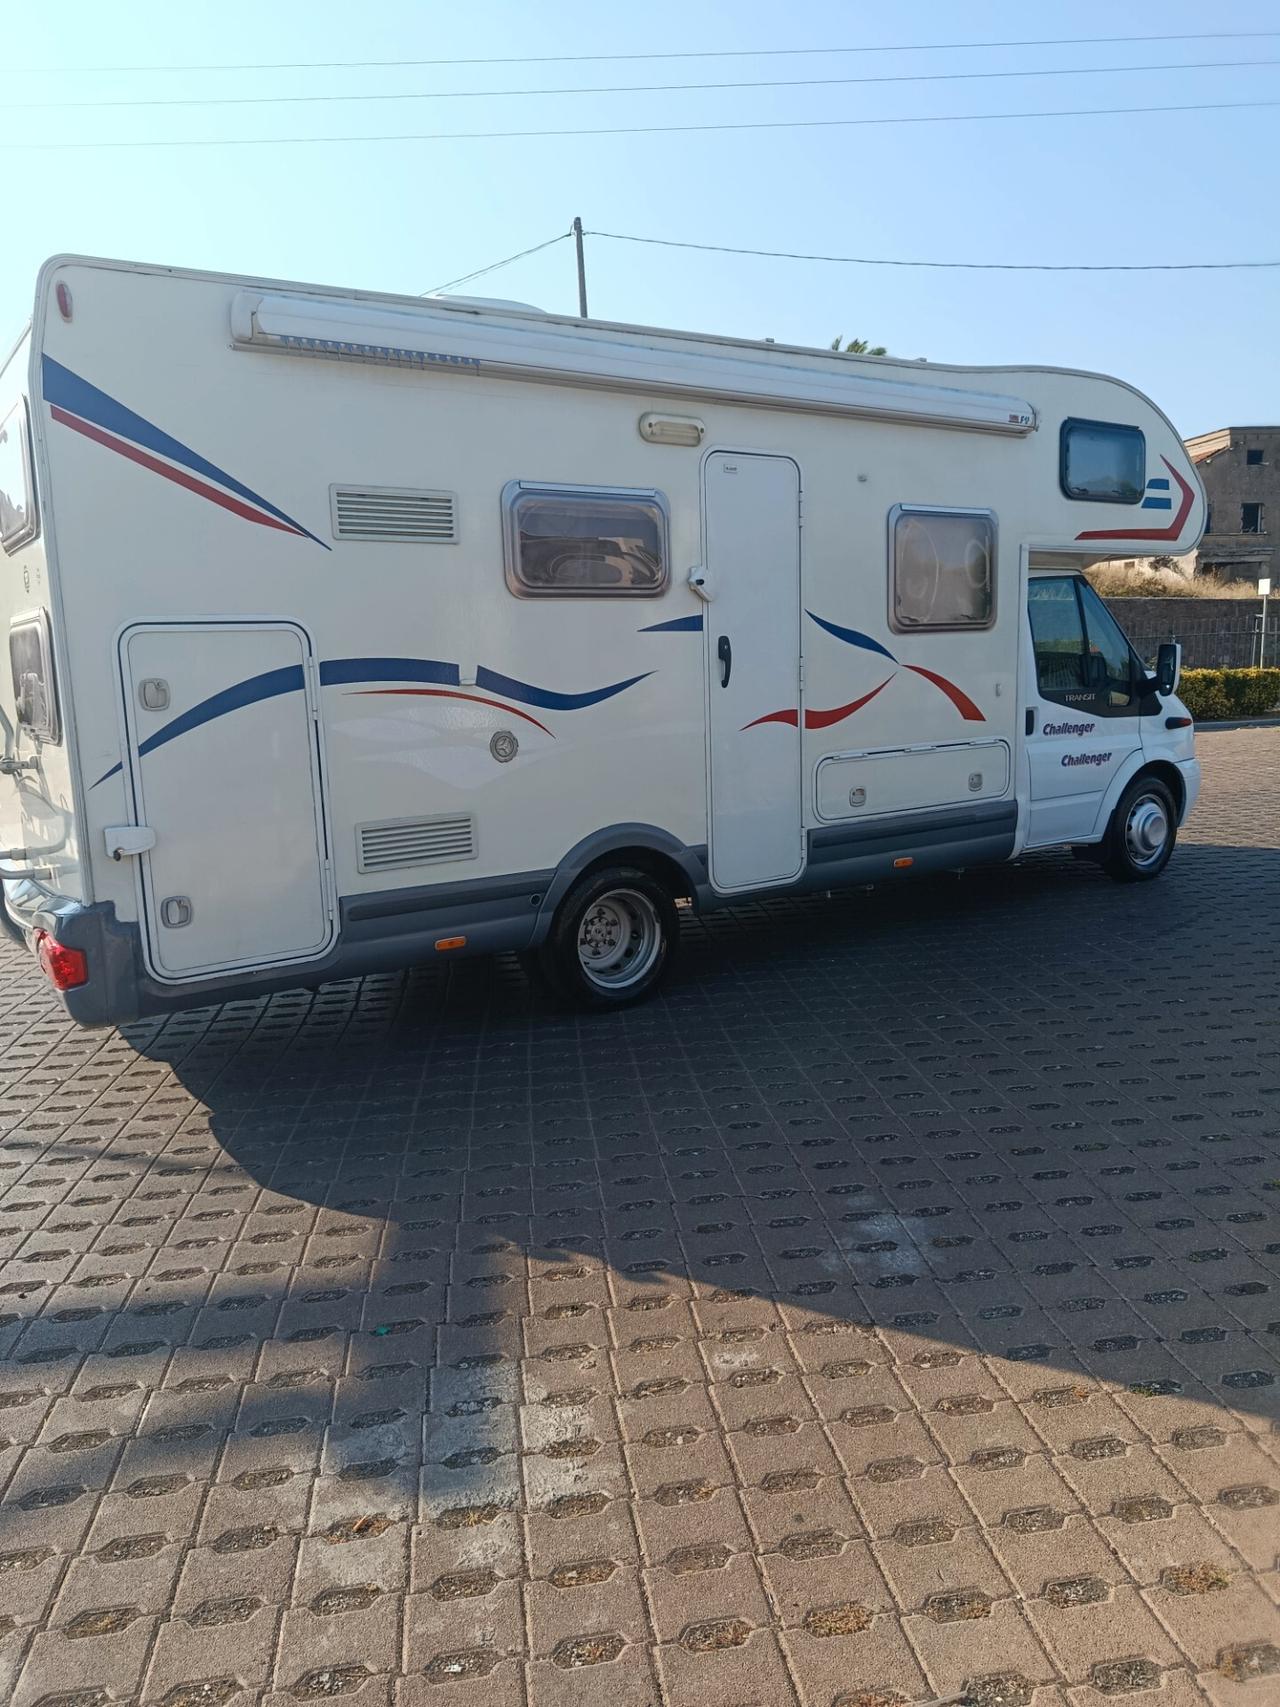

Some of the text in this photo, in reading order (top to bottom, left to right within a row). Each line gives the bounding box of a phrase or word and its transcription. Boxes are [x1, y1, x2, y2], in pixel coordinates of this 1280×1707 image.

[1065, 693, 1096, 702] TRANSIT
[1043, 722, 1095, 736] Challenger
[1061, 752, 1112, 767] Challenger
